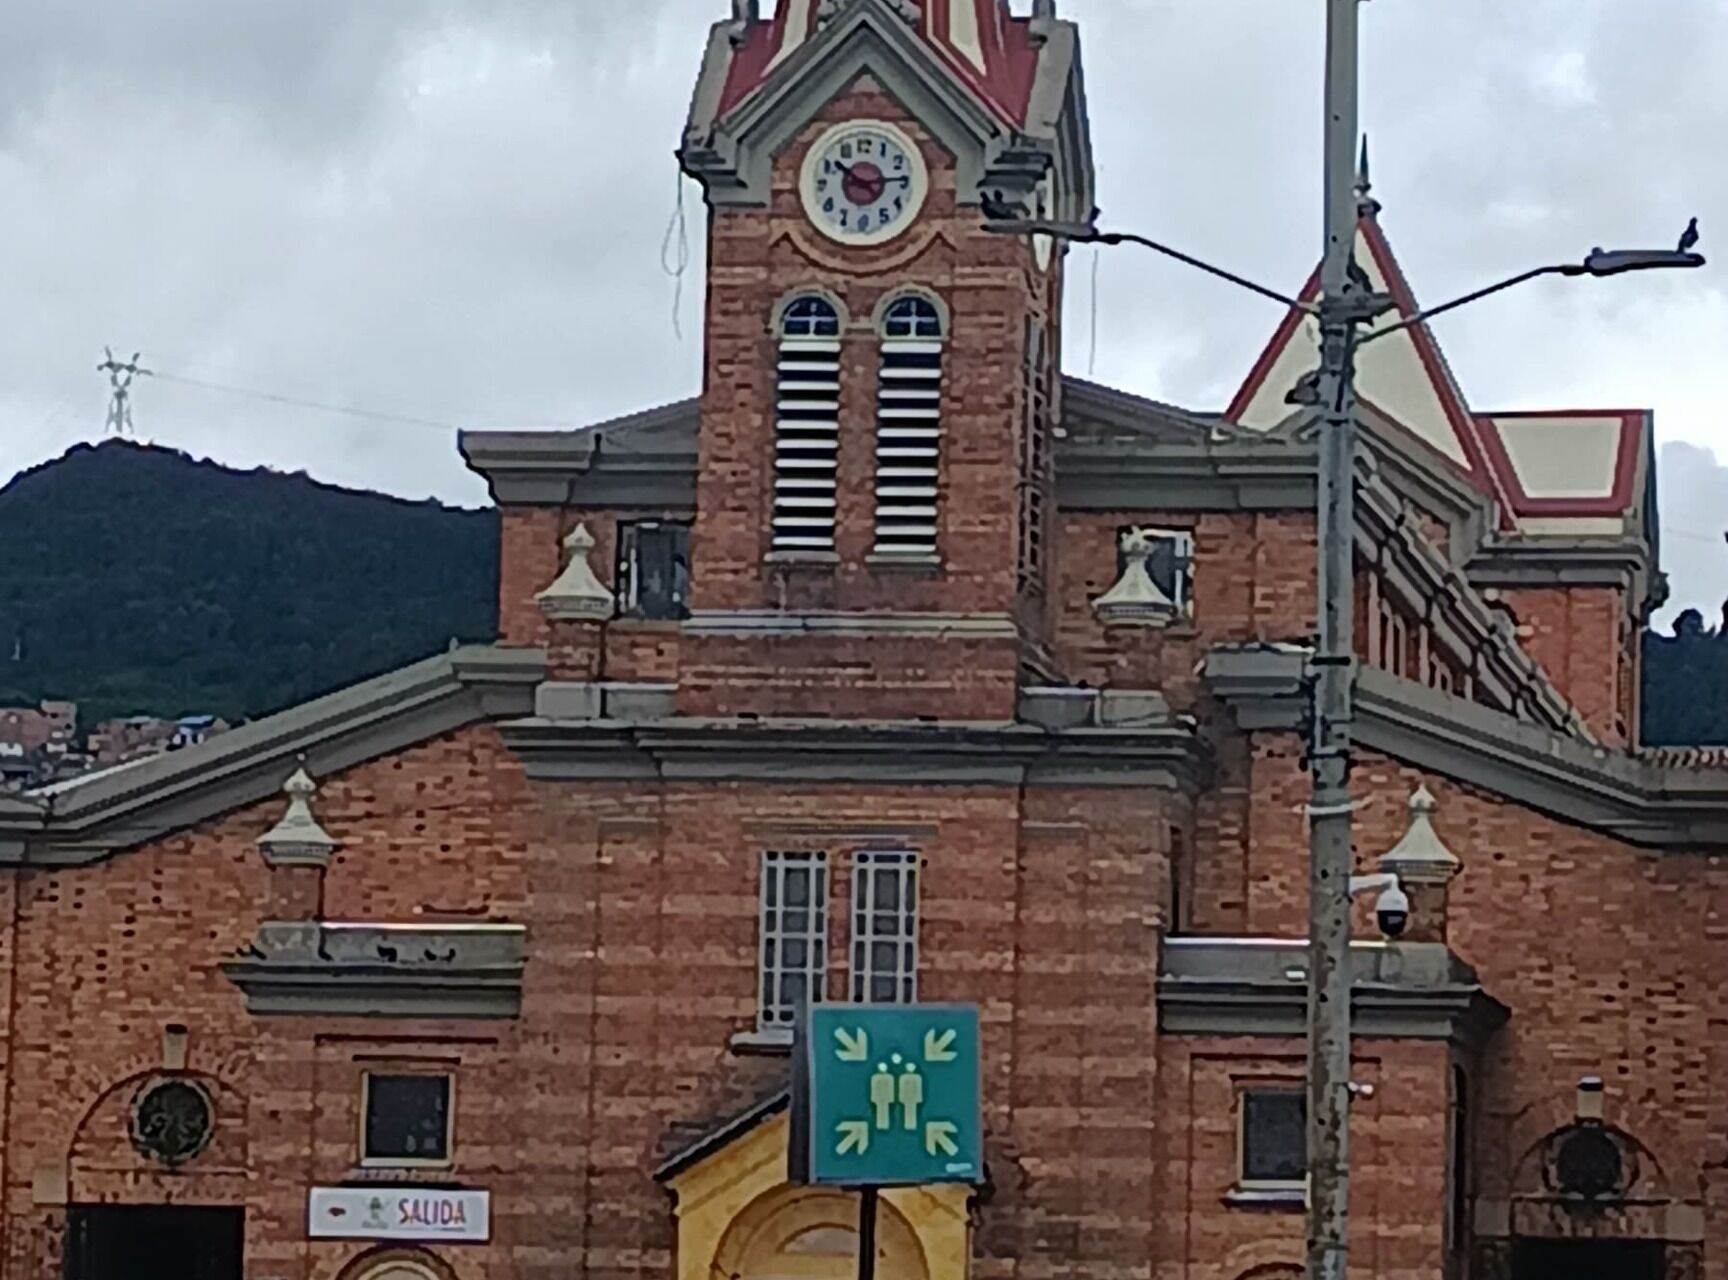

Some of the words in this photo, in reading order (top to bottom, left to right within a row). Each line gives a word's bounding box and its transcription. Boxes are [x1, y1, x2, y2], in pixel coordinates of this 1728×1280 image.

[880, 142, 887, 158] 1
[879, 207, 890, 225] 5
[398, 1198, 467, 1226] SALIDA
